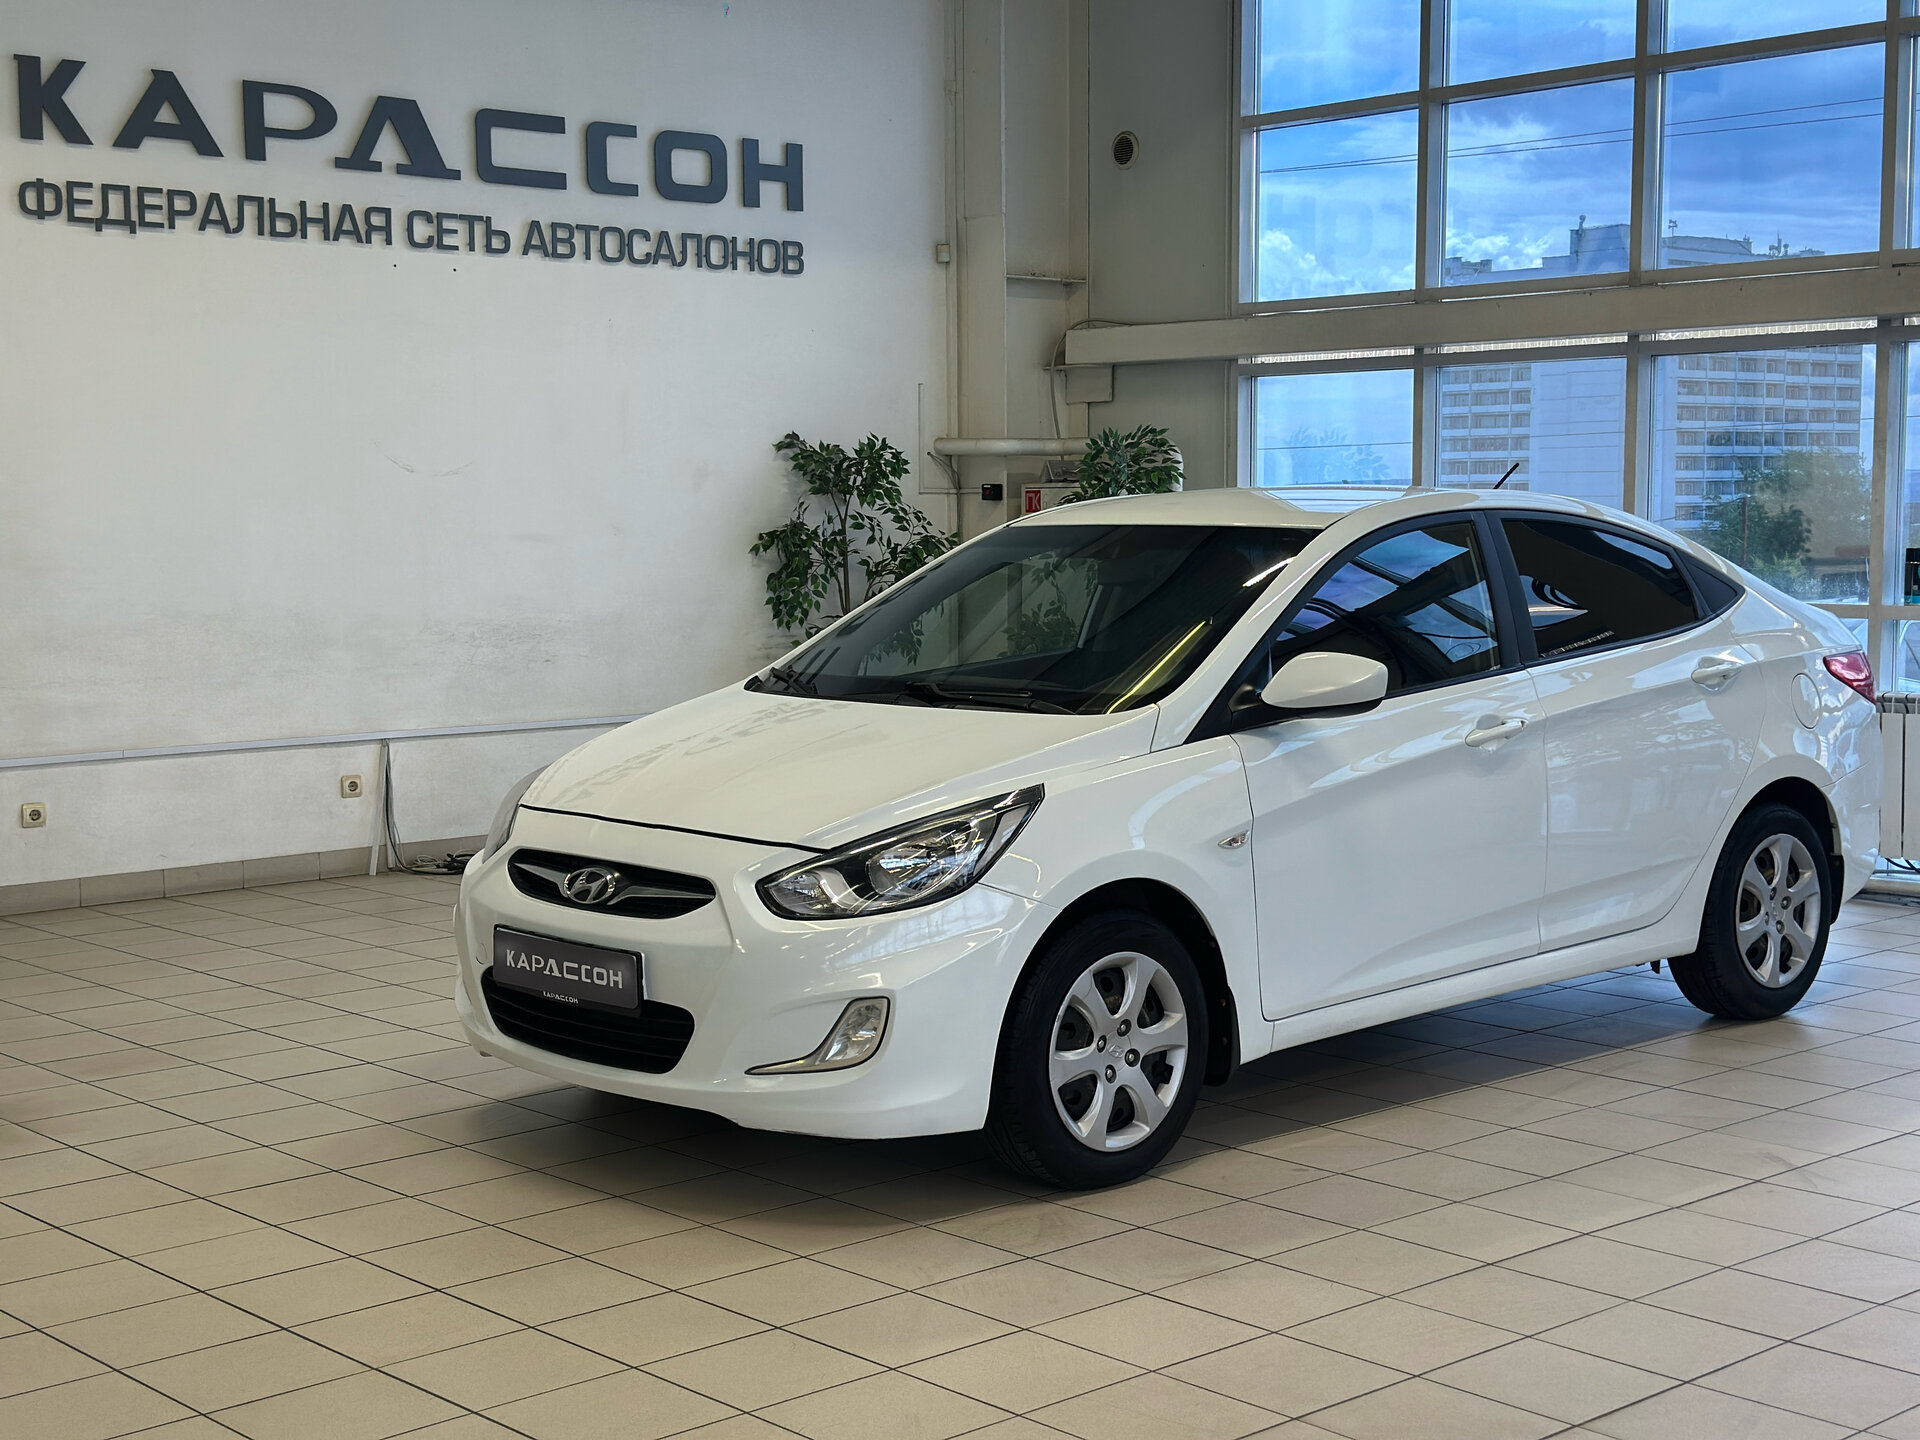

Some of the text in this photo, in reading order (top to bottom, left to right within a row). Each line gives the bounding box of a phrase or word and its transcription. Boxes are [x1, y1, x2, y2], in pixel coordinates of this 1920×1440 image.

[18, 177, 805, 275] ФЕДЕРАЛЬНАЯ СЕТЬ АВТОСАЛОНОВ
[1026, 492, 1041, 511] ПК
